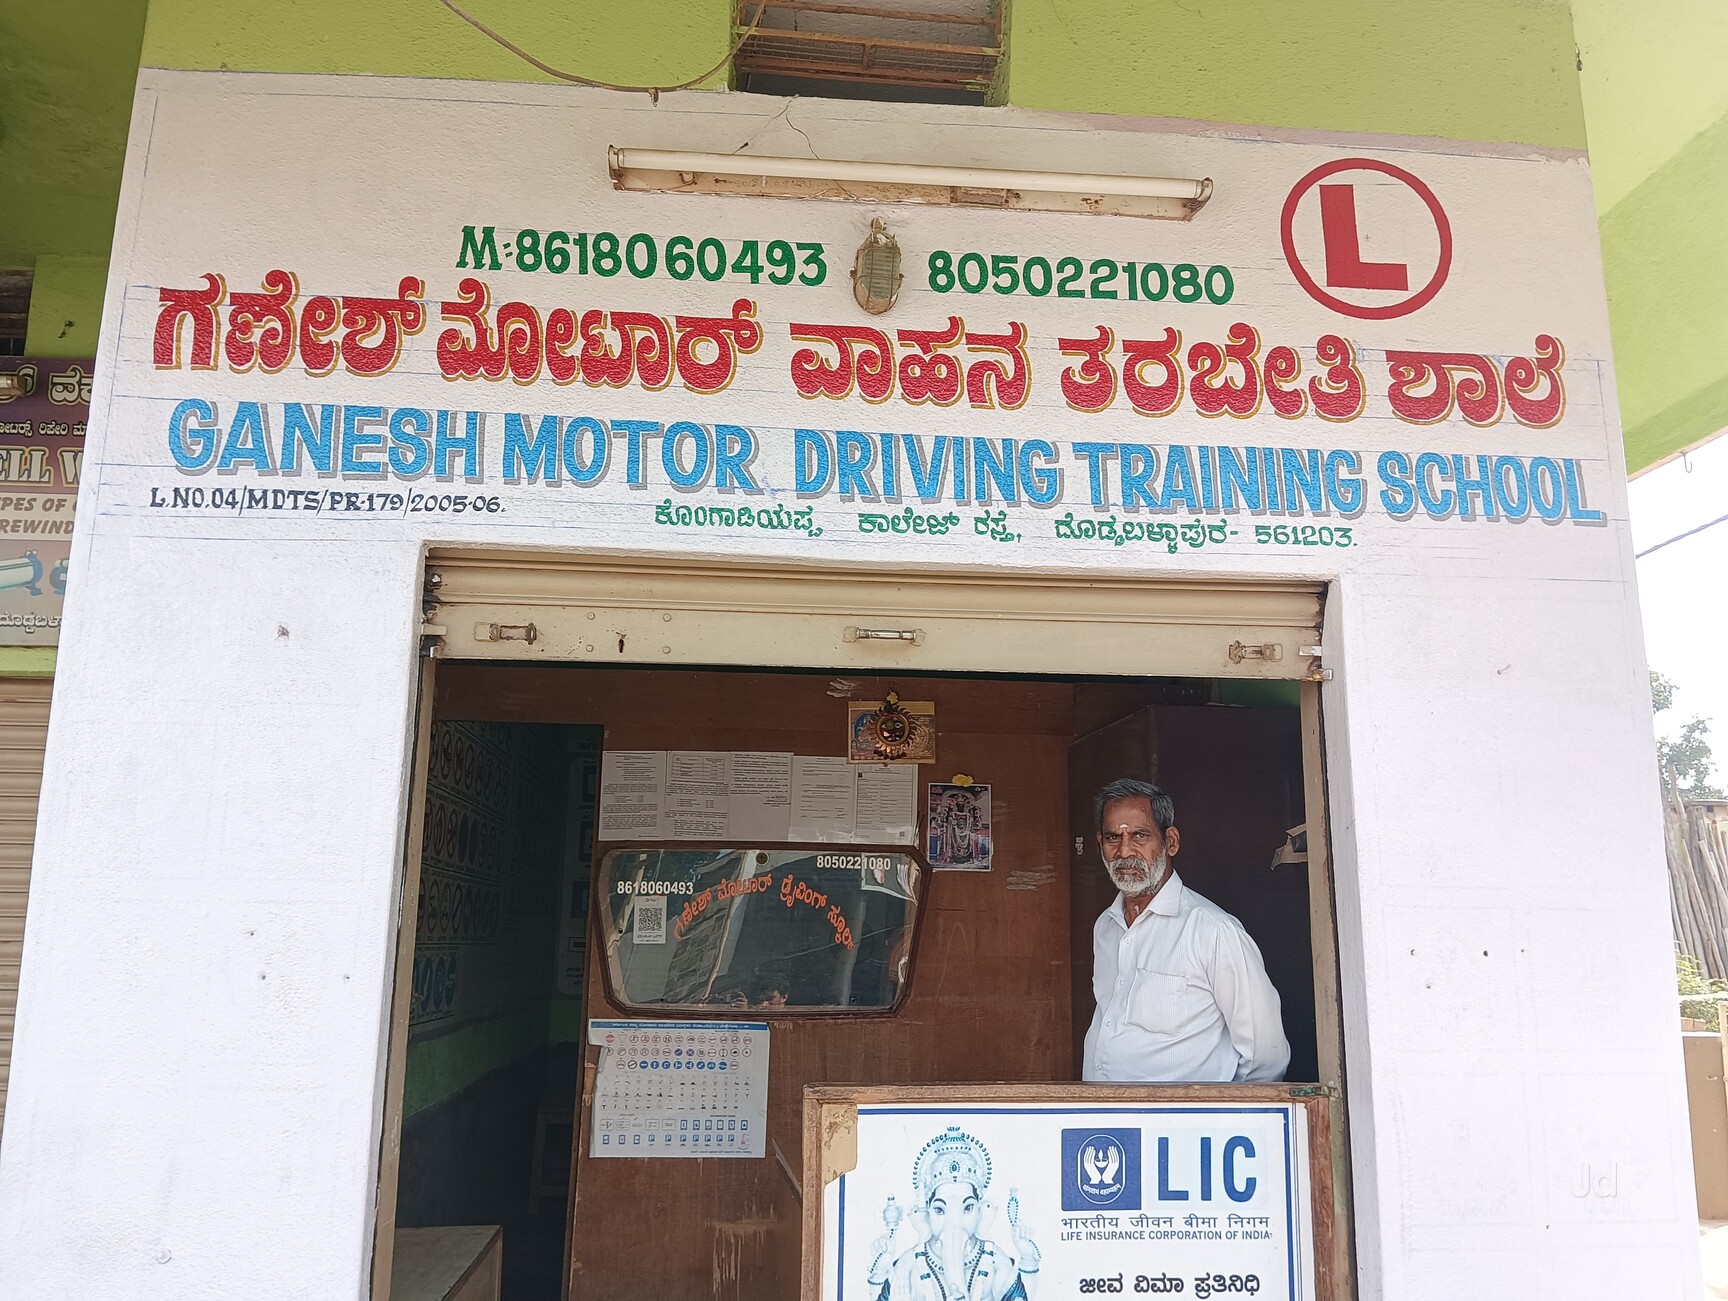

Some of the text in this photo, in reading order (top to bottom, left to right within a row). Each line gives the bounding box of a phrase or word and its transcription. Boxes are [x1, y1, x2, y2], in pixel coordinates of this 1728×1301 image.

[1318, 183, 1409, 291] L
[928, 250, 1235, 305] 8050221080
[152, 269, 1567, 430] ಗಣೇಶ್ ಮೋಟಾರ್ ವಾಹನ ತರಬೇತಿ ಶಾಲೆ
[168, 399, 1607, 528] GANESH MOTOR DRIVING TRAINING SCHOOL
[42, 498, 67, 512] OF
[857, 507, 960, 536] ಕಾಲೇಜ್
[1254, 524, 1358, 547] 561203.
[816, 855, 891, 870] 8050221080
[617, 881, 694, 895] 8618060493
[1158, 1136, 1256, 1202] LIC
[1061, 1214, 1270, 1229] भारतीय जीवन बीमा निगम
[1061, 1230, 1270, 1241] LIFE INSURANCE CORPORATION OF INDIA
[1079, 1272, 1261, 1300] ಜೀವ ವಿಮಾ ಪ್ರತಿನಿಧಿ
